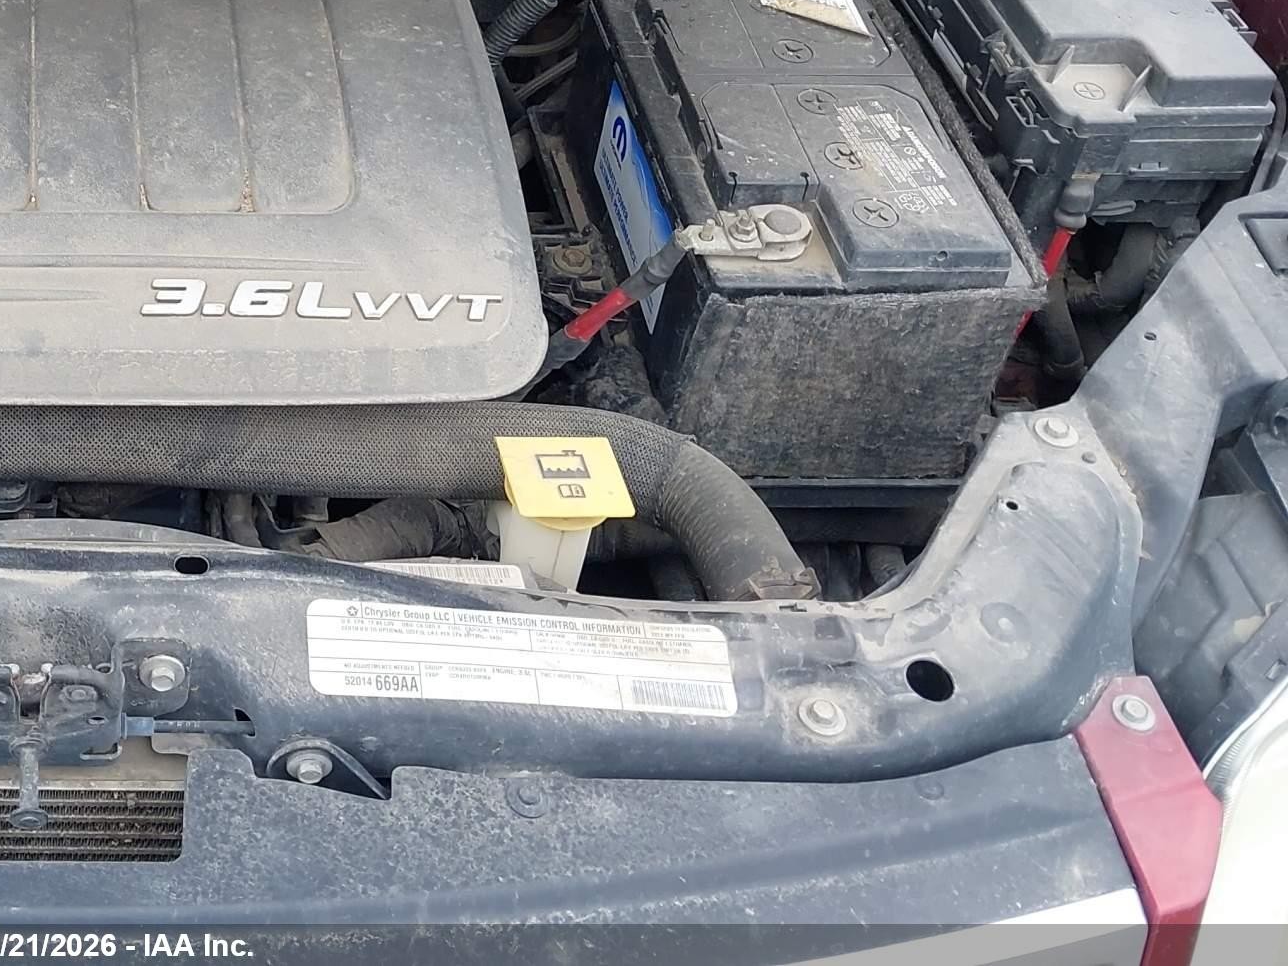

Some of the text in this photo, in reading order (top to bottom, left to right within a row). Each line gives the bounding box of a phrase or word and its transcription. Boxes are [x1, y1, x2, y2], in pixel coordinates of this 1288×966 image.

[140, 278, 503, 321] 3.6L VVT
[364, 606, 400, 619] Chrysler
[404, 609, 430, 621] Group
[433, 610, 449, 621] LLC
[458, 612, 642, 636] VEHICLE EMISSION CONTROL INFORMATION
[344, 674, 419, 693] 52014 669AA
